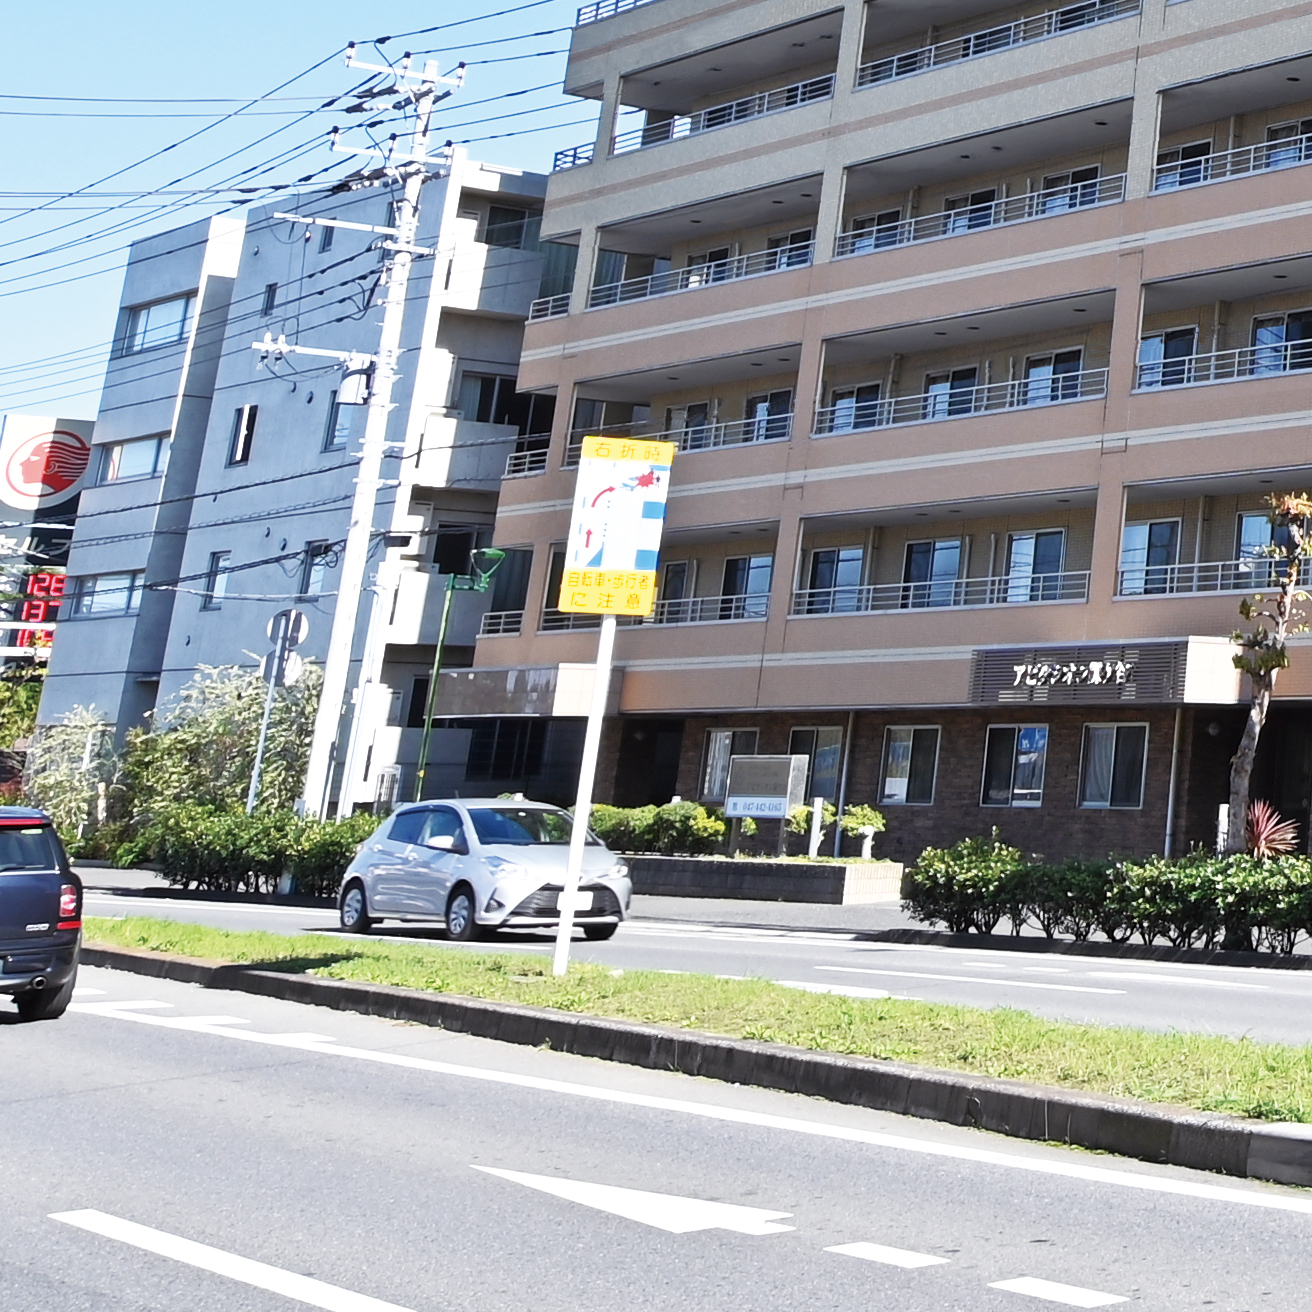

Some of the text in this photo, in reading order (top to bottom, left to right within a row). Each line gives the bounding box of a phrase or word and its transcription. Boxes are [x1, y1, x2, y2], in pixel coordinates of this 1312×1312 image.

[594, 442, 661, 461] 右折時
[567, 572, 650, 590] 自転車・歩行者
[570, 591, 642, 610] に注意
